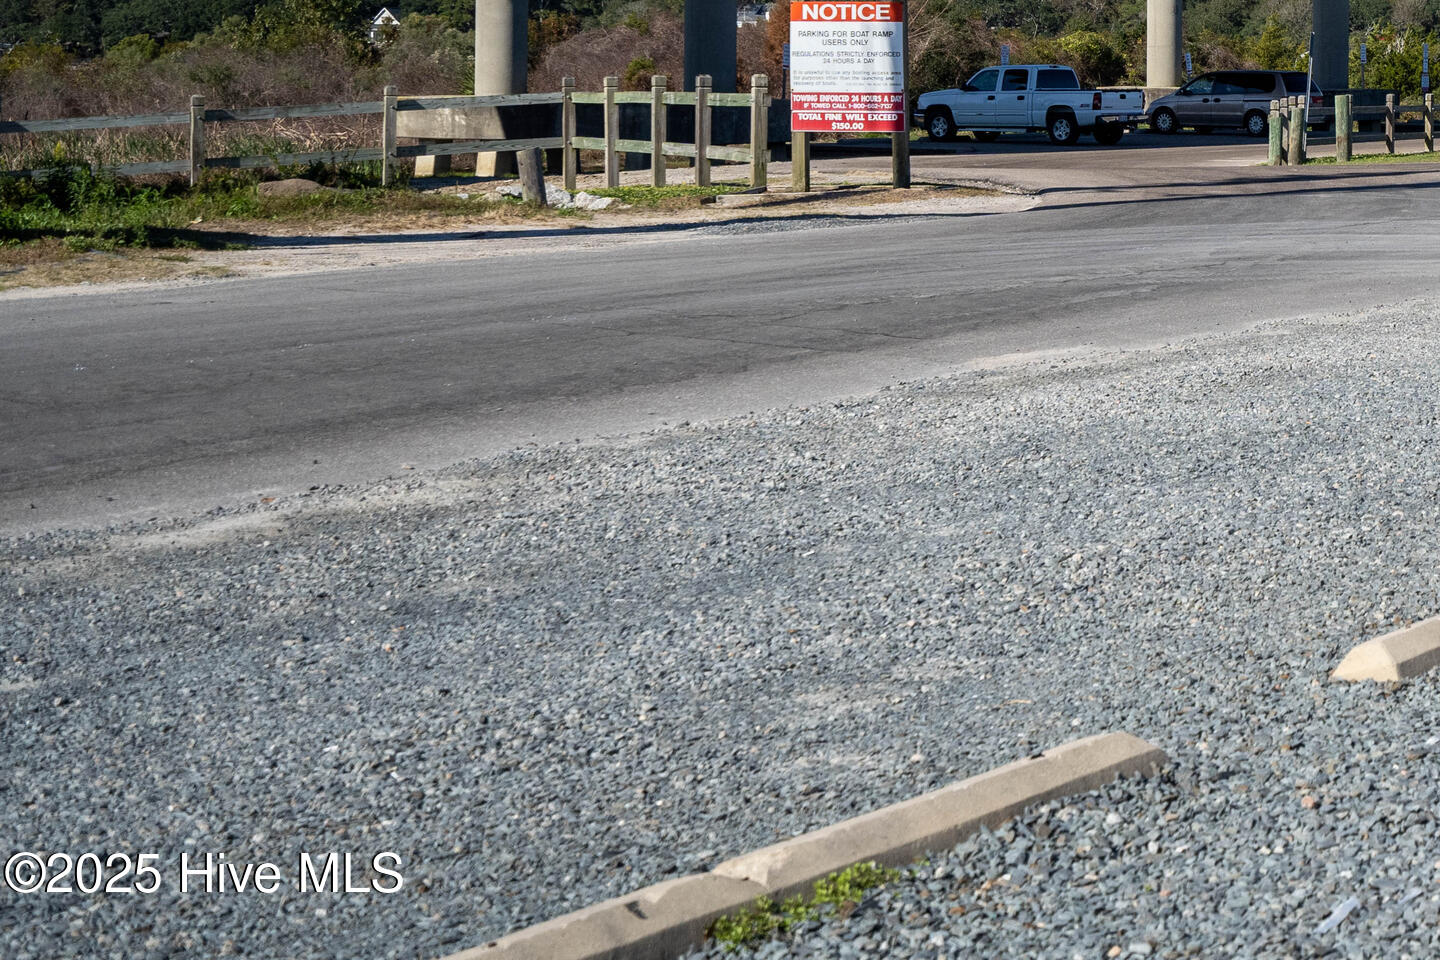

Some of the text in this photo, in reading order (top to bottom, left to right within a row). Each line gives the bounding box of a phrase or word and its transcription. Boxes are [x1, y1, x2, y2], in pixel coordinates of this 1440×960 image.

[802, 3, 891, 20] NOTICE
[798, 30, 894, 38] PARKING FOR BOAT RAMP
[822, 38, 868, 46] USERS ONLY
[792, 50, 900, 58] REGULATIONS STRICTLY ENFORCED
[832, 122, 864, 130] $150.00
